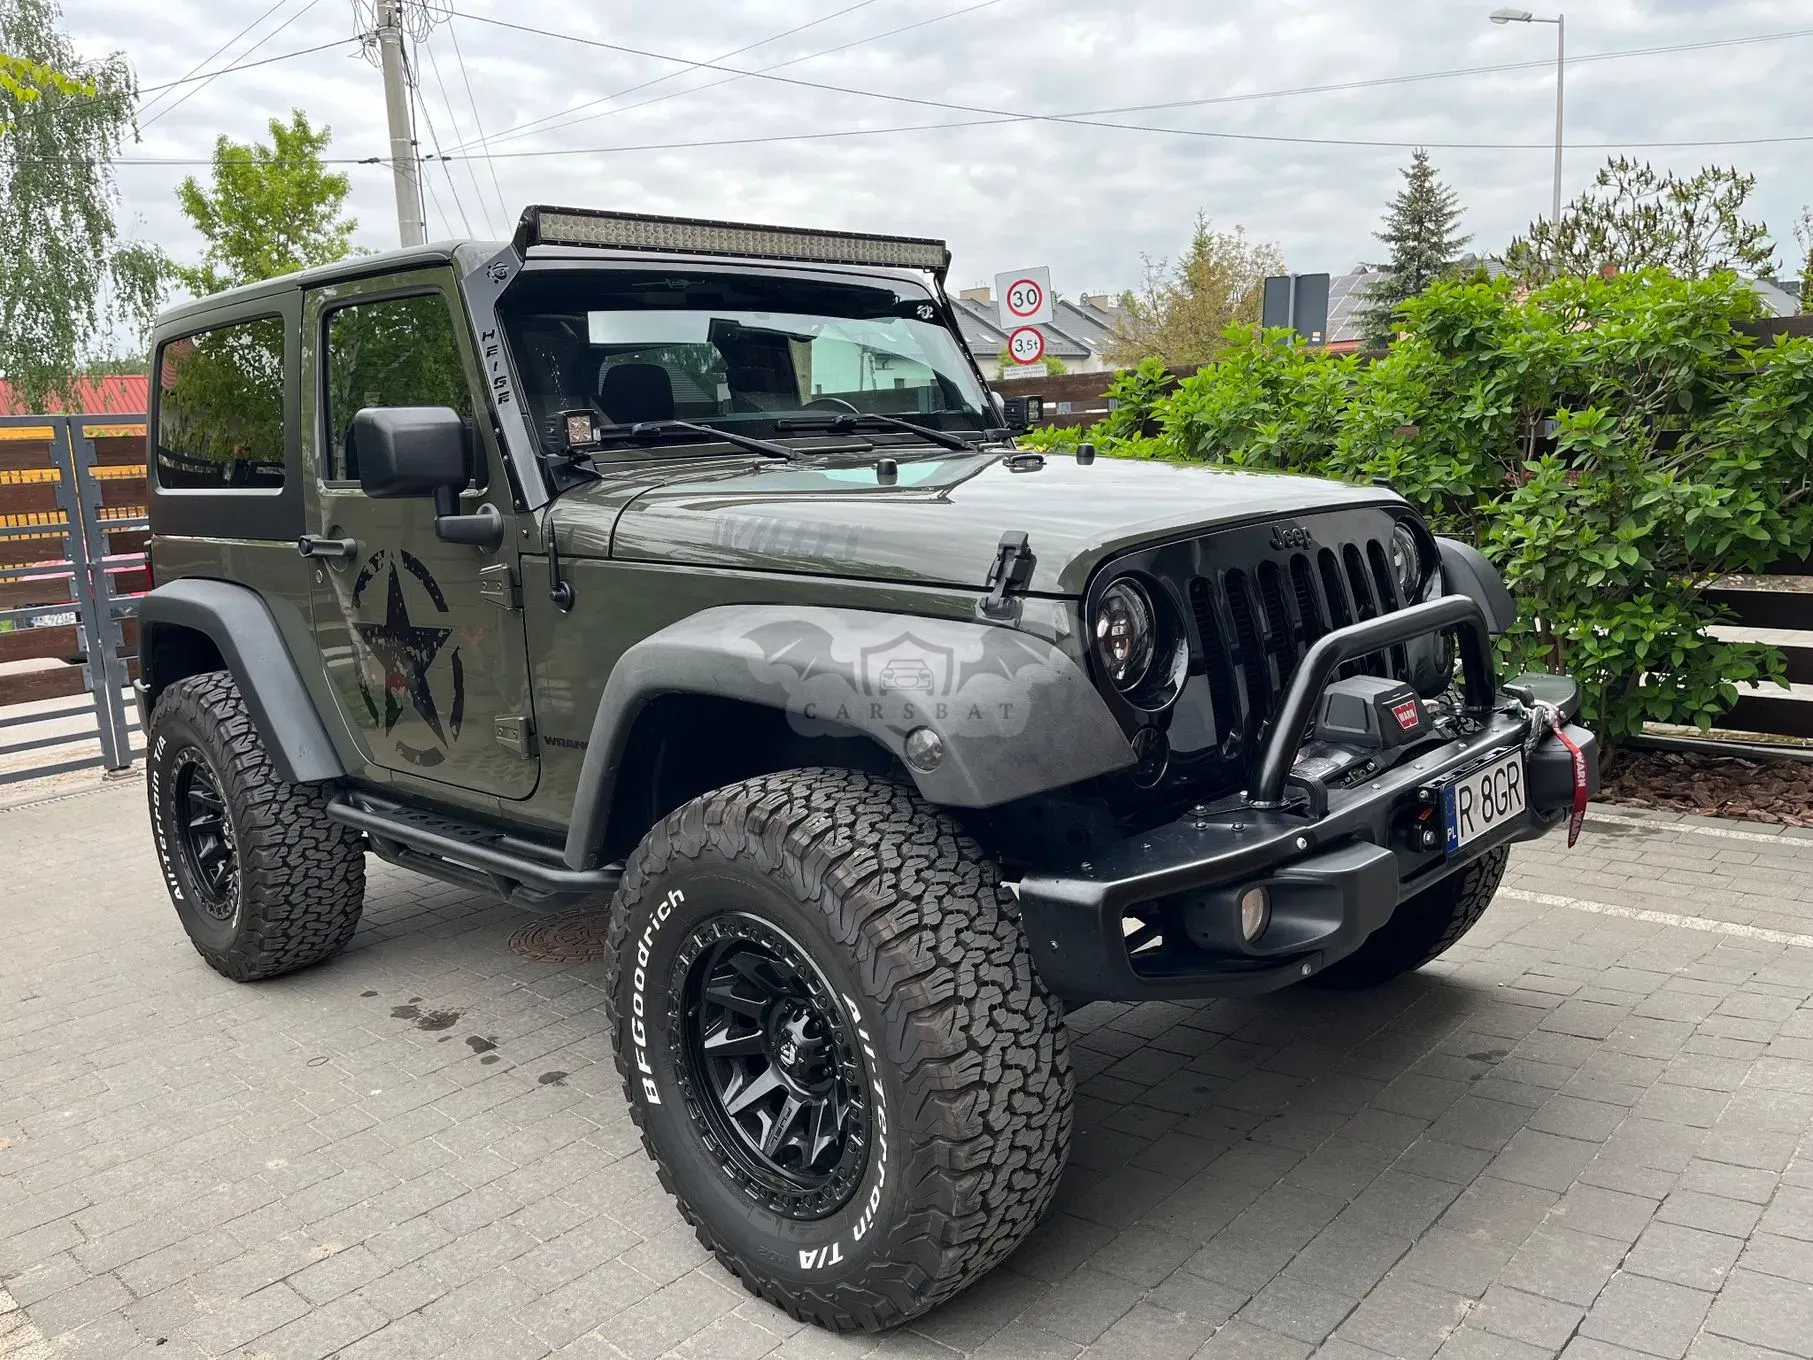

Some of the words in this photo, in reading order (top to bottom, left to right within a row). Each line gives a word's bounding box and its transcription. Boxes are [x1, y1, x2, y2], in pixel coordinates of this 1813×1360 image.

[1012, 288, 1038, 308] 30
[1014, 338, 1039, 354] 3,5t
[1269, 525, 1312, 551] Jeep
[1398, 708, 1416, 722] WARN
[153, 735, 167, 762] T/A
[1575, 751, 1587, 787] WARN
[1481, 761, 1522, 823] 8GR
[1447, 826, 1457, 842] PL
[630, 888, 686, 1105] BFGoodrich
[799, 1242, 844, 1269] T/A
